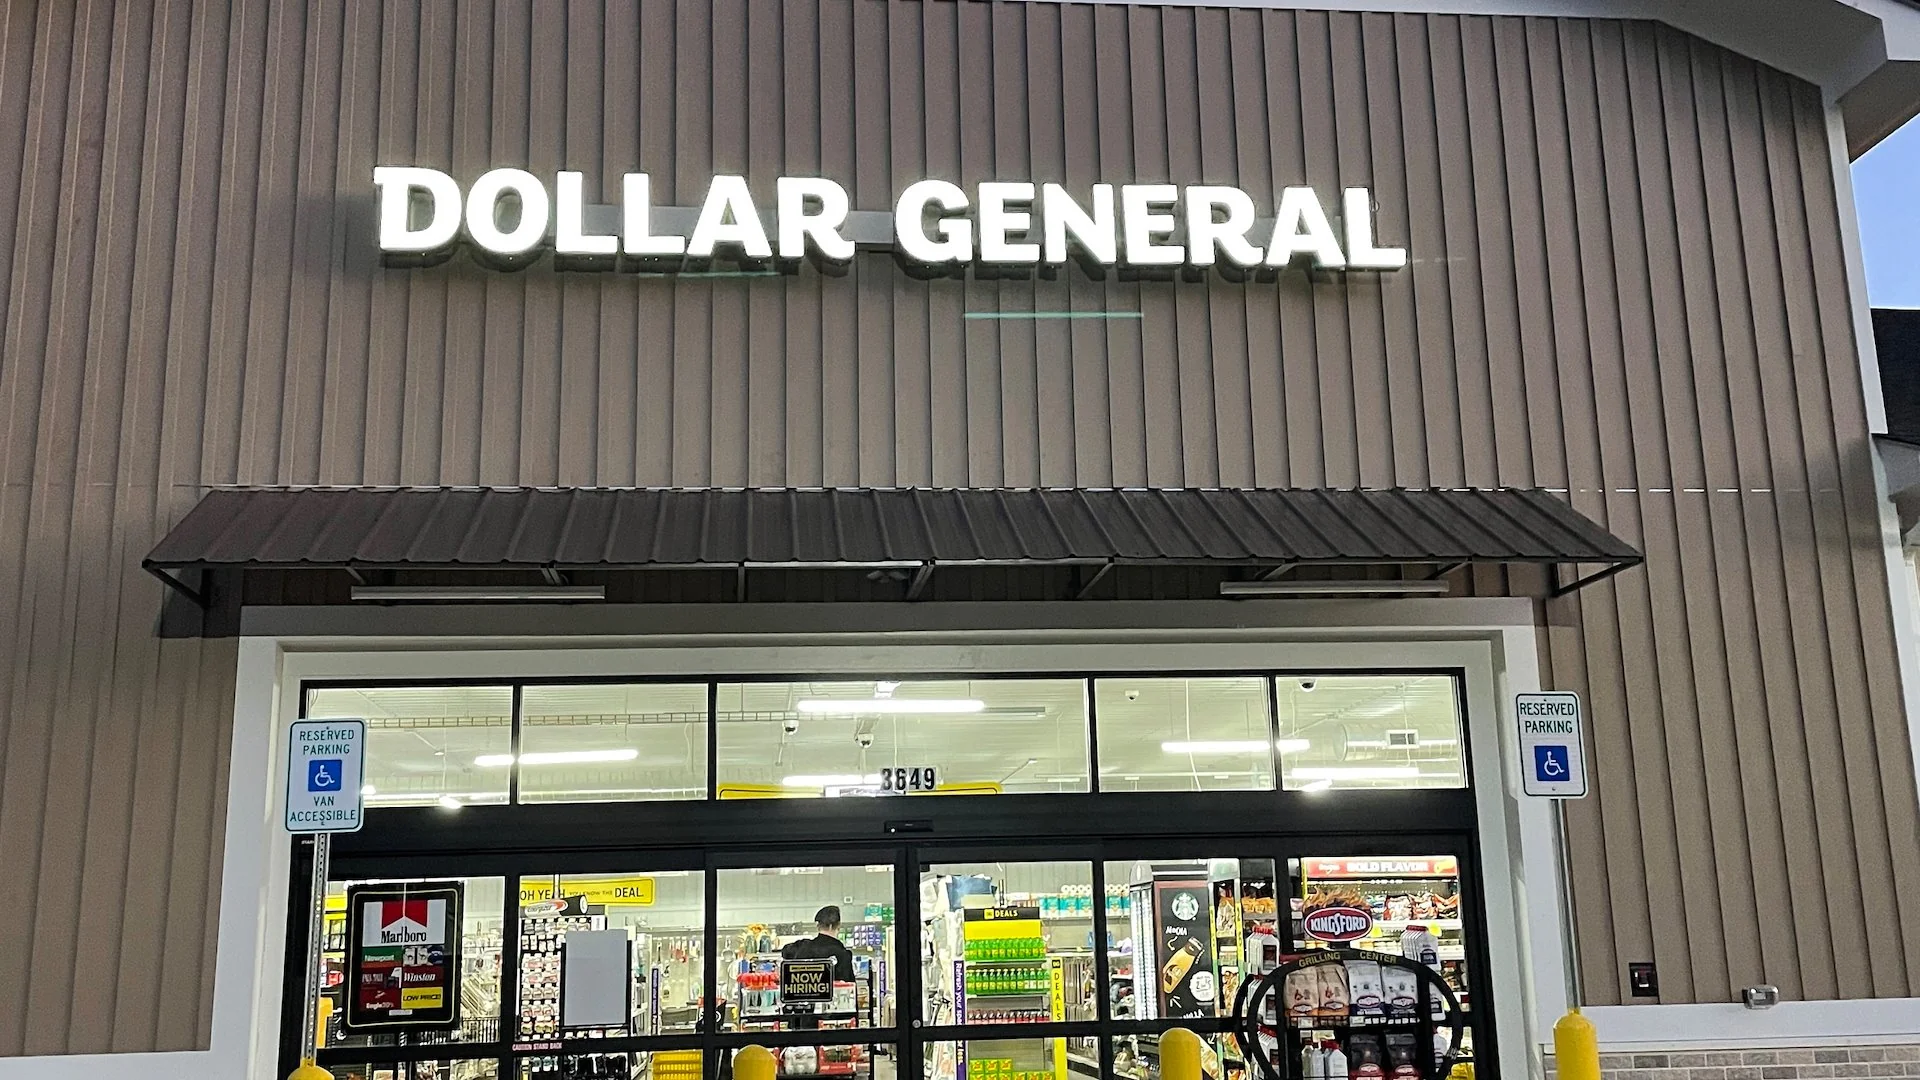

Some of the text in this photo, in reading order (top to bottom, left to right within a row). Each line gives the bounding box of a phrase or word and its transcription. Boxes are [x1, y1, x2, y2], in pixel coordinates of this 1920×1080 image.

[374, 166, 1407, 268] DOLLAR GENERAL
[1519, 702, 1575, 716] RESERVED
[1524, 720, 1573, 734] PARKING
[299, 729, 355, 741] RESERVED
[302, 744, 350, 755] PARKING
[881, 767, 936, 791] 3649
[313, 796, 335, 807] VAN
[289, 809, 357, 822] ACCESSIBLE
[1381, 861, 1429, 873] FLAVOR
[520, 890, 535, 901] OH
[995, 909, 1018, 918] DEALS
[1310, 912, 1367, 936] KINGSFORD
[381, 926, 427, 944] Marlboro
[1298, 950, 1397, 968] GRILLING CENTER
[403, 972, 436, 983] Winston
[790, 972, 823, 984] NOW
[784, 982, 830, 994] HIRING!
[1054, 972, 1062, 1021] DEALS
